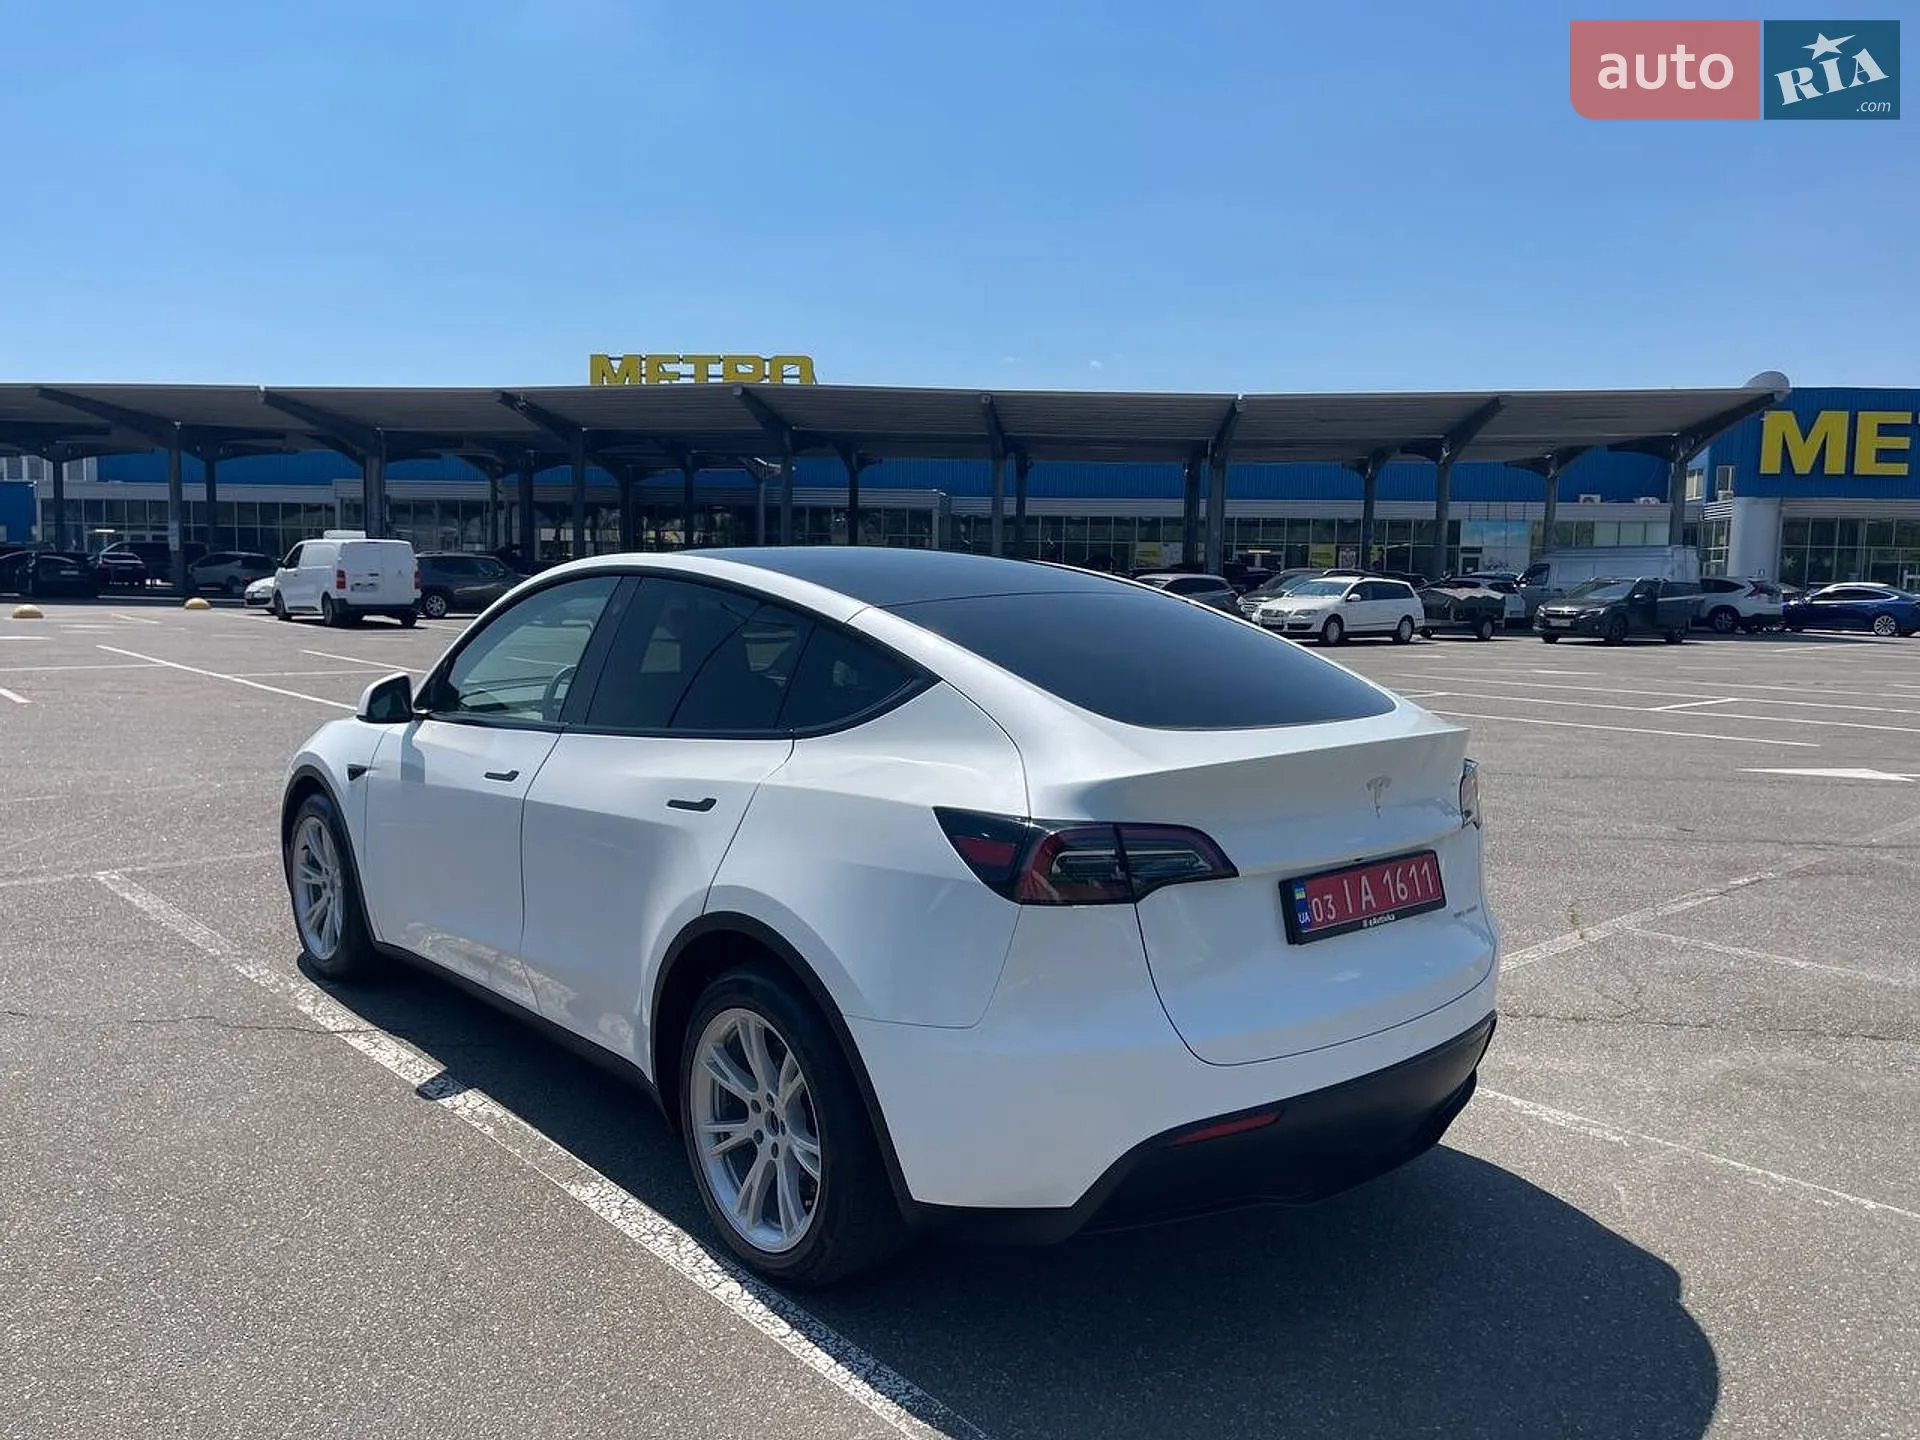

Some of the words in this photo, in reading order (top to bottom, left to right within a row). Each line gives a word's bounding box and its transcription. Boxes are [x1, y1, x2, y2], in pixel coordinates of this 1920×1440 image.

[1760, 410, 1920, 475] ME
[1298, 912, 1310, 924] UA
[1311, 894, 1337, 923] 03
[1382, 861, 1434, 904] 1611
